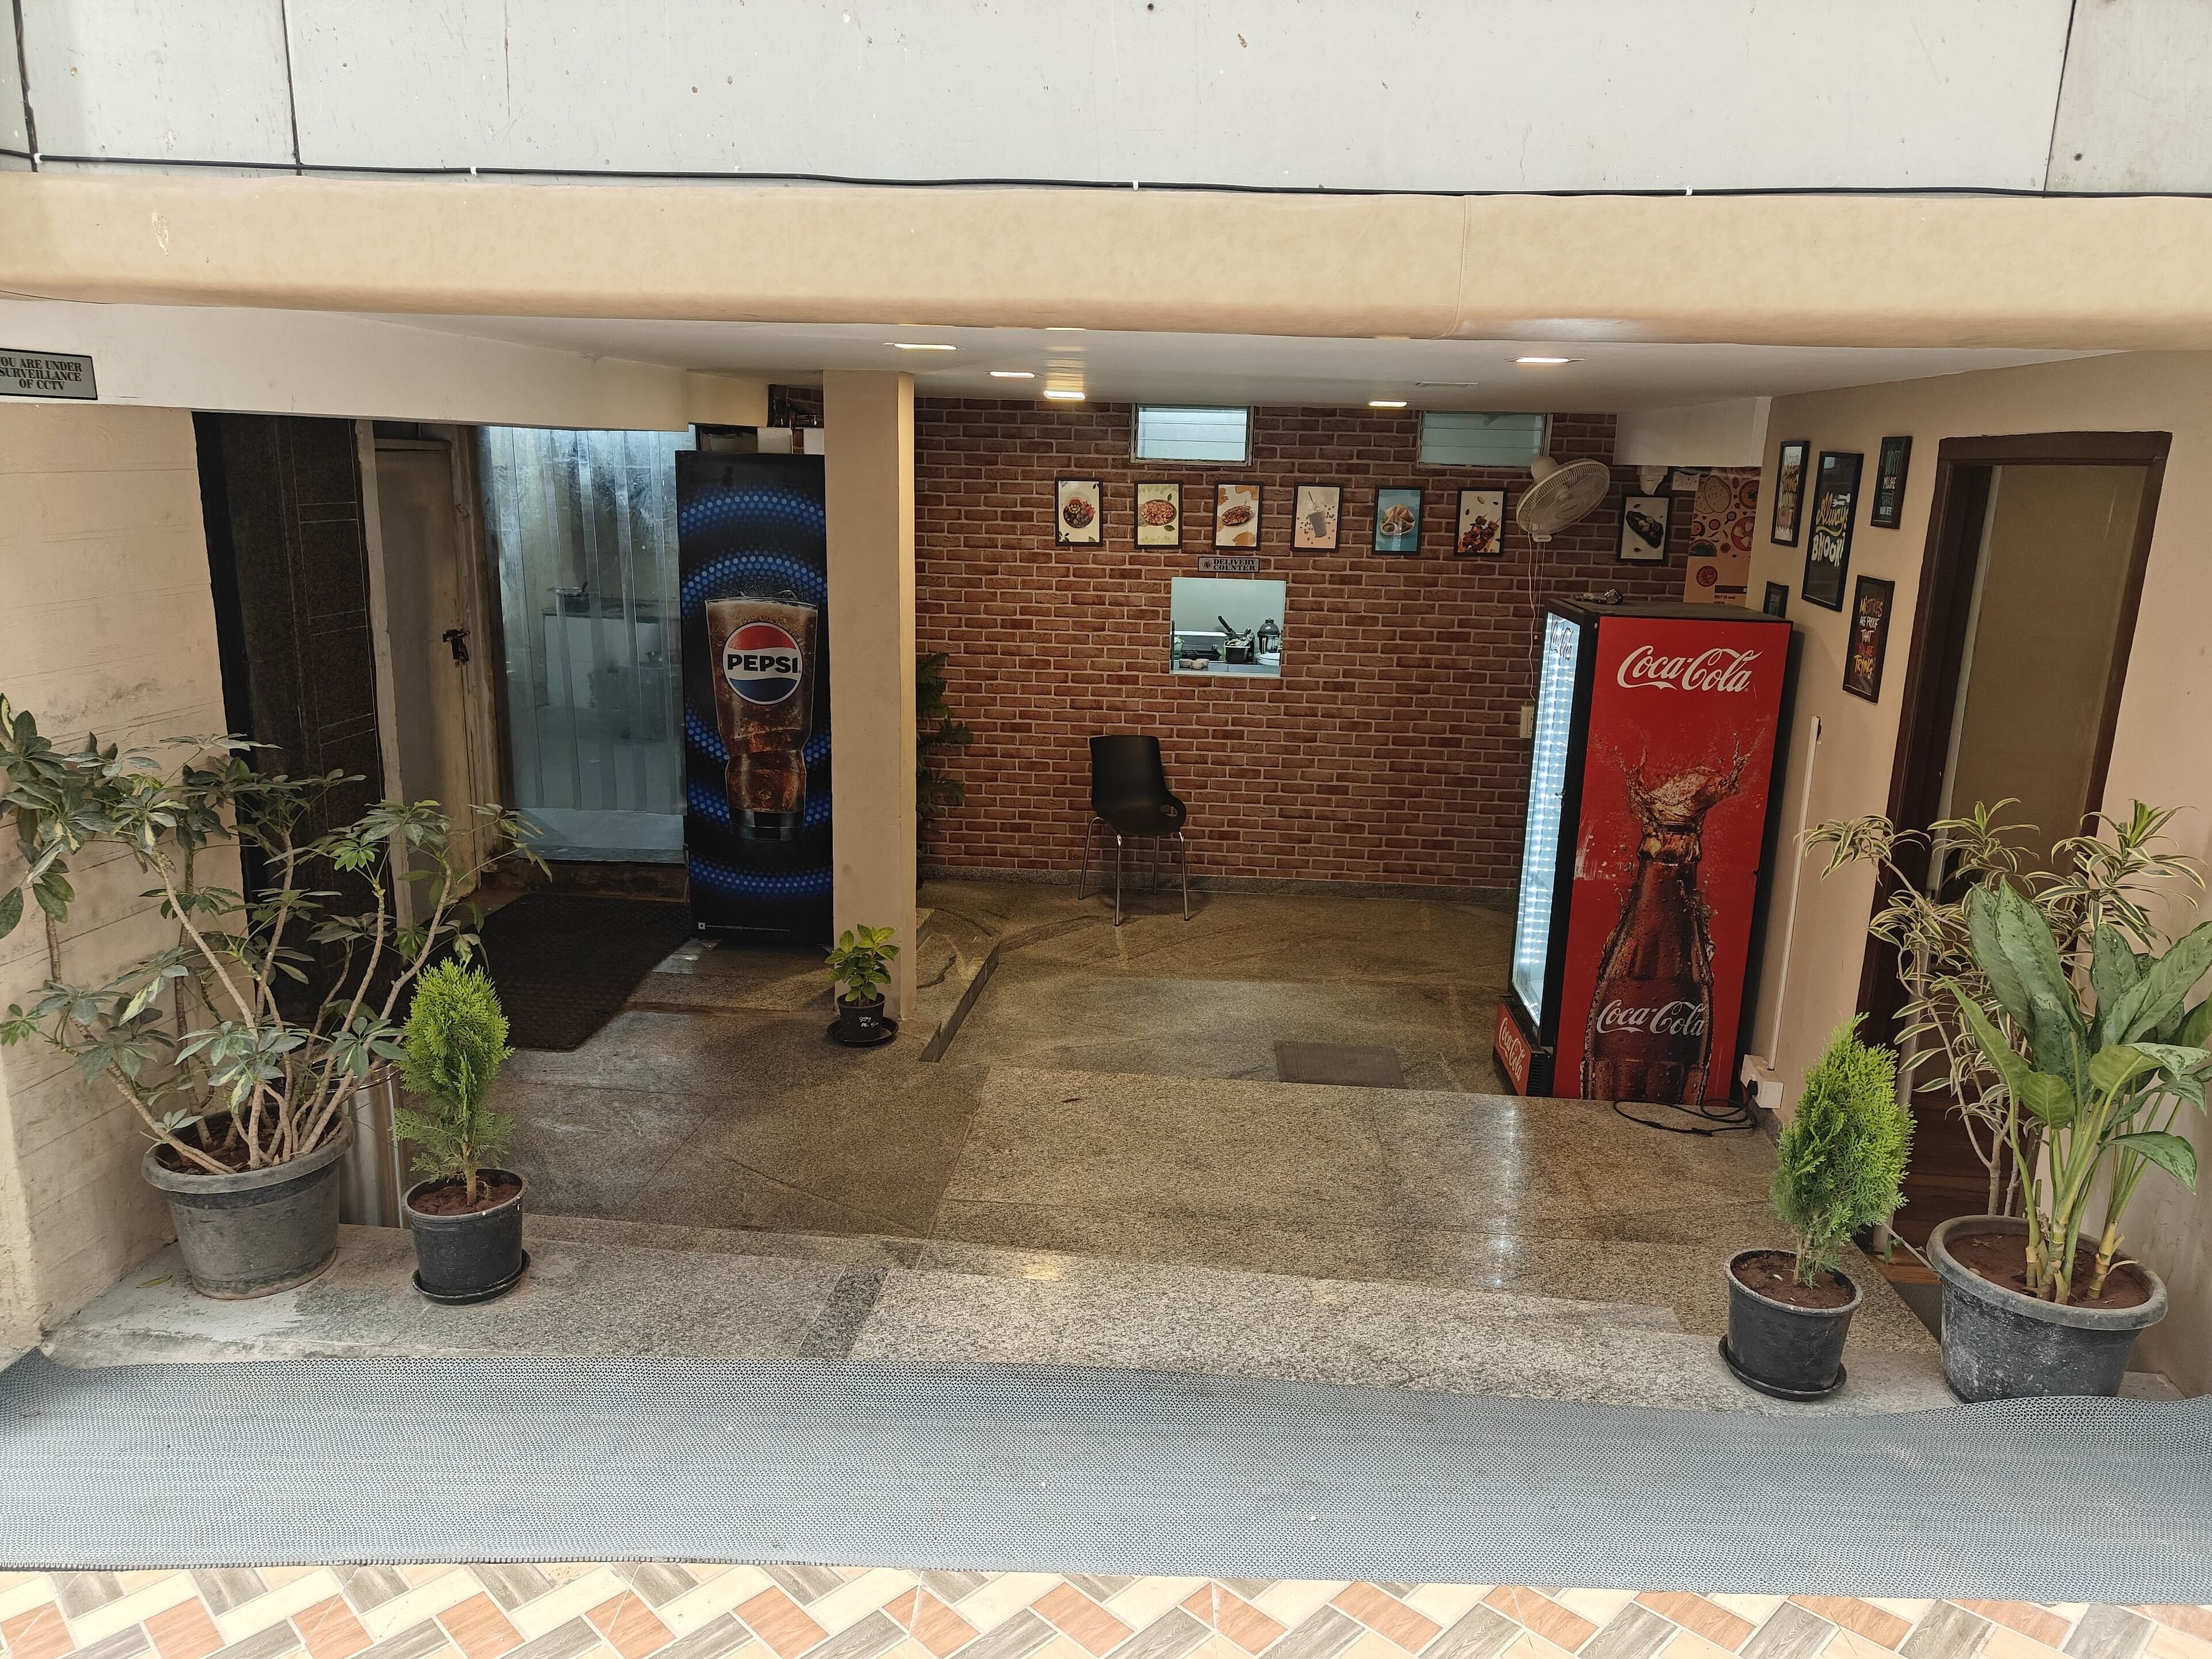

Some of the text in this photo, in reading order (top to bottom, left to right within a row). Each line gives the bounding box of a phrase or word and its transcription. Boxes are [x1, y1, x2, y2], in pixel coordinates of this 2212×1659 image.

[20, 358, 43, 369] ARE
[45, 359, 82, 372] UNDER
[0, 367, 82, 381] SURVEILLANCE
[18, 378, 65, 390] OF CCTV
[1866, 616, 1880, 630] PROOF
[1861, 629, 1875, 643] THAT
[727, 654, 798, 673] PEPSI
[1617, 645, 1763, 692] Coca-Cola
[1854, 654, 1873, 680] TRYING
[1596, 999, 1706, 1036] Coca-Cola
[1499, 1017, 1526, 1082] Coca-Cola
